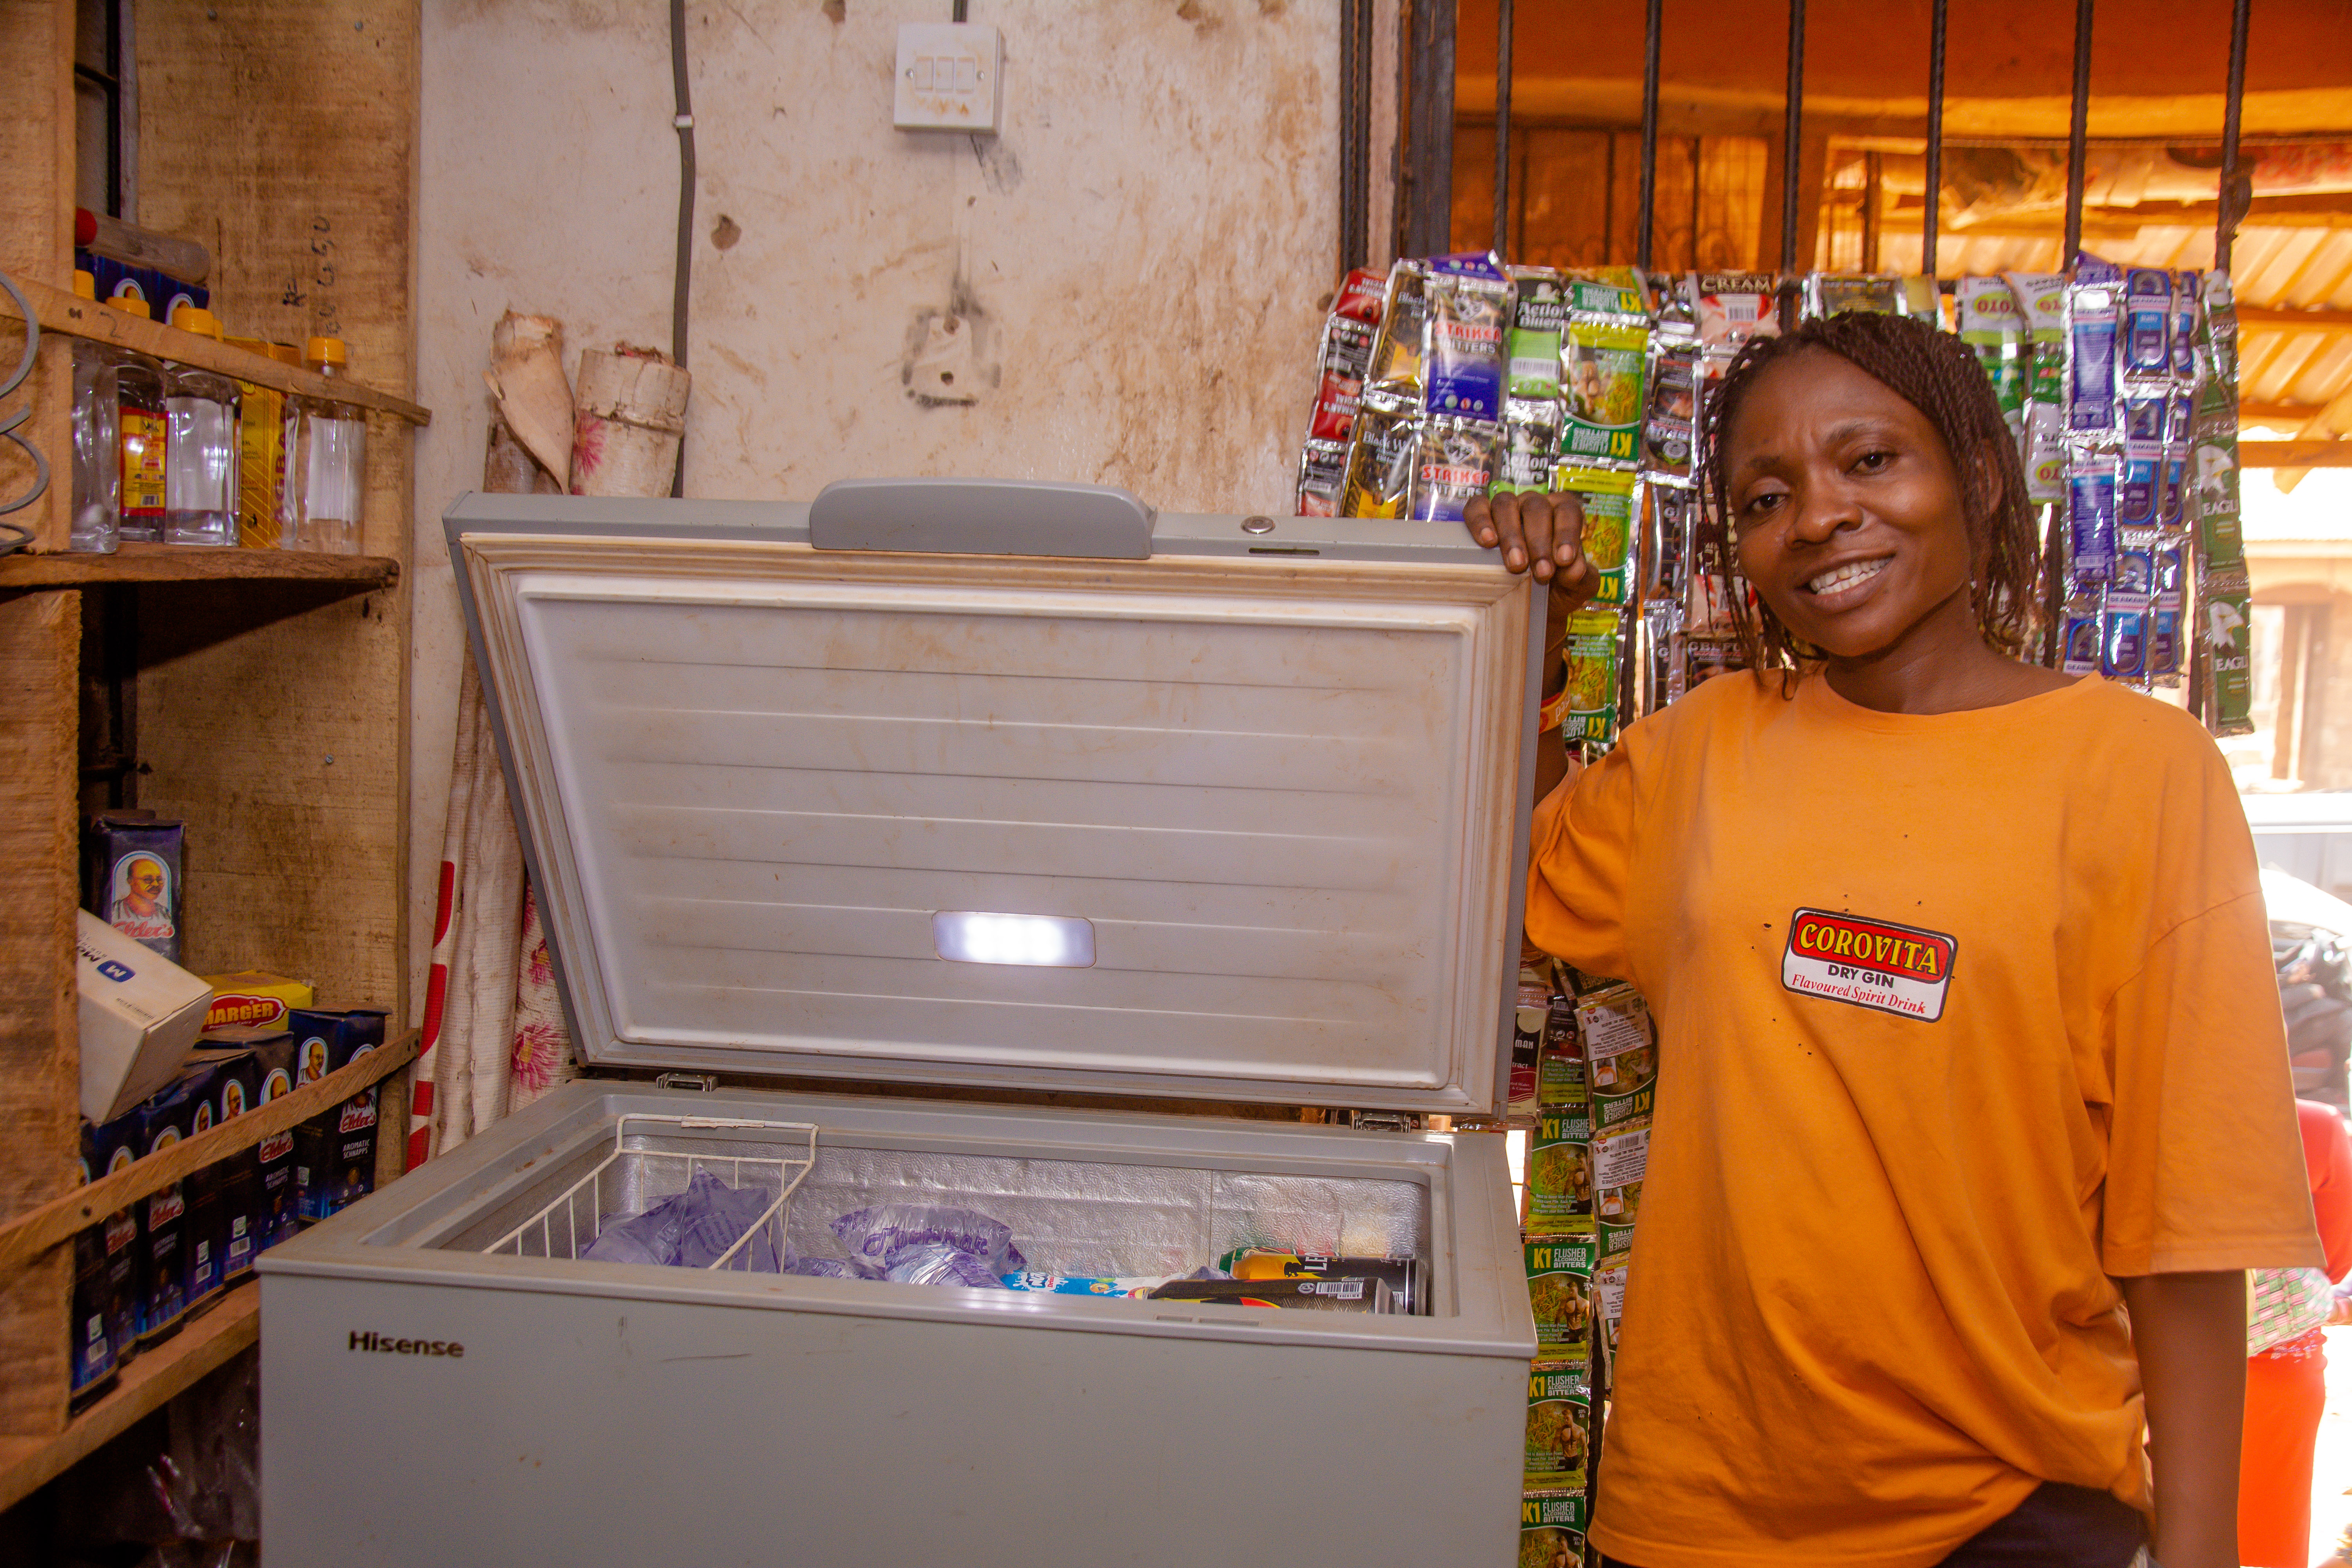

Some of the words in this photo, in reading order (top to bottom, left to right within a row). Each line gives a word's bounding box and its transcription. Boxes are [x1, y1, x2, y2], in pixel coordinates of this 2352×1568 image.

[1701, 278, 1771, 293] CREAM
[1620, 292, 1642, 313] K1
[1435, 321, 1502, 343] STRIKER
[1443, 338, 1497, 354] BITTERS
[1363, 430, 1390, 449] Black
[1573, 427, 1610, 437] BITTERS
[1571, 441, 1609, 454] FLUSHER
[1609, 432, 1633, 458] K1
[1421, 464, 1490, 485] STRIKER
[1429, 482, 1483, 498] BITTERS
[1597, 576, 1619, 600] K1
[1586, 717, 1607, 740] K1
[1800, 922, 1940, 975] COROVITA
[1828, 964, 1859, 980] DRY
[1862, 971, 1894, 988] GIN
[1791, 973, 1851, 996] Flavoured
[1851, 986, 1887, 1004] Spirit
[1887, 994, 1926, 1014] Drink
[1515, 1039, 1534, 1049] MAN
[1603, 1096, 1633, 1110] BITTERS
[1604, 1102, 1633, 1115] ALCOHOLIC
[1633, 1091, 1650, 1113] K1
[341, 1111, 376, 1131] Elder's
[1603, 1107, 1633, 1124] FLUSHER
[1542, 1118, 1560, 1139] K1
[1562, 1119, 1589, 1129] FLUSHE
[261, 1138, 293, 1161] Elder's
[343, 1138, 371, 1152] AROMATIC
[343, 1147, 368, 1160] SCHNAPPS
[1601, 1176, 1626, 1185] VENTURES
[1608, 1229, 1634, 1239] ITTERS
[1609, 1233, 1633, 1243] COHOLIC
[1608, 1239, 1632, 1252] USHER
[1534, 1248, 1552, 1269] K1
[1554, 1247, 1586, 1258] FLUSHER
[348, 1330, 465, 1358] Hisense
[1528, 1376, 1545, 1397] K1
[1548, 1375, 1580, 1385] FLUSHER
[1522, 1502, 1540, 1523] K1
[1543, 1502, 1575, 1513] FLUSHER
